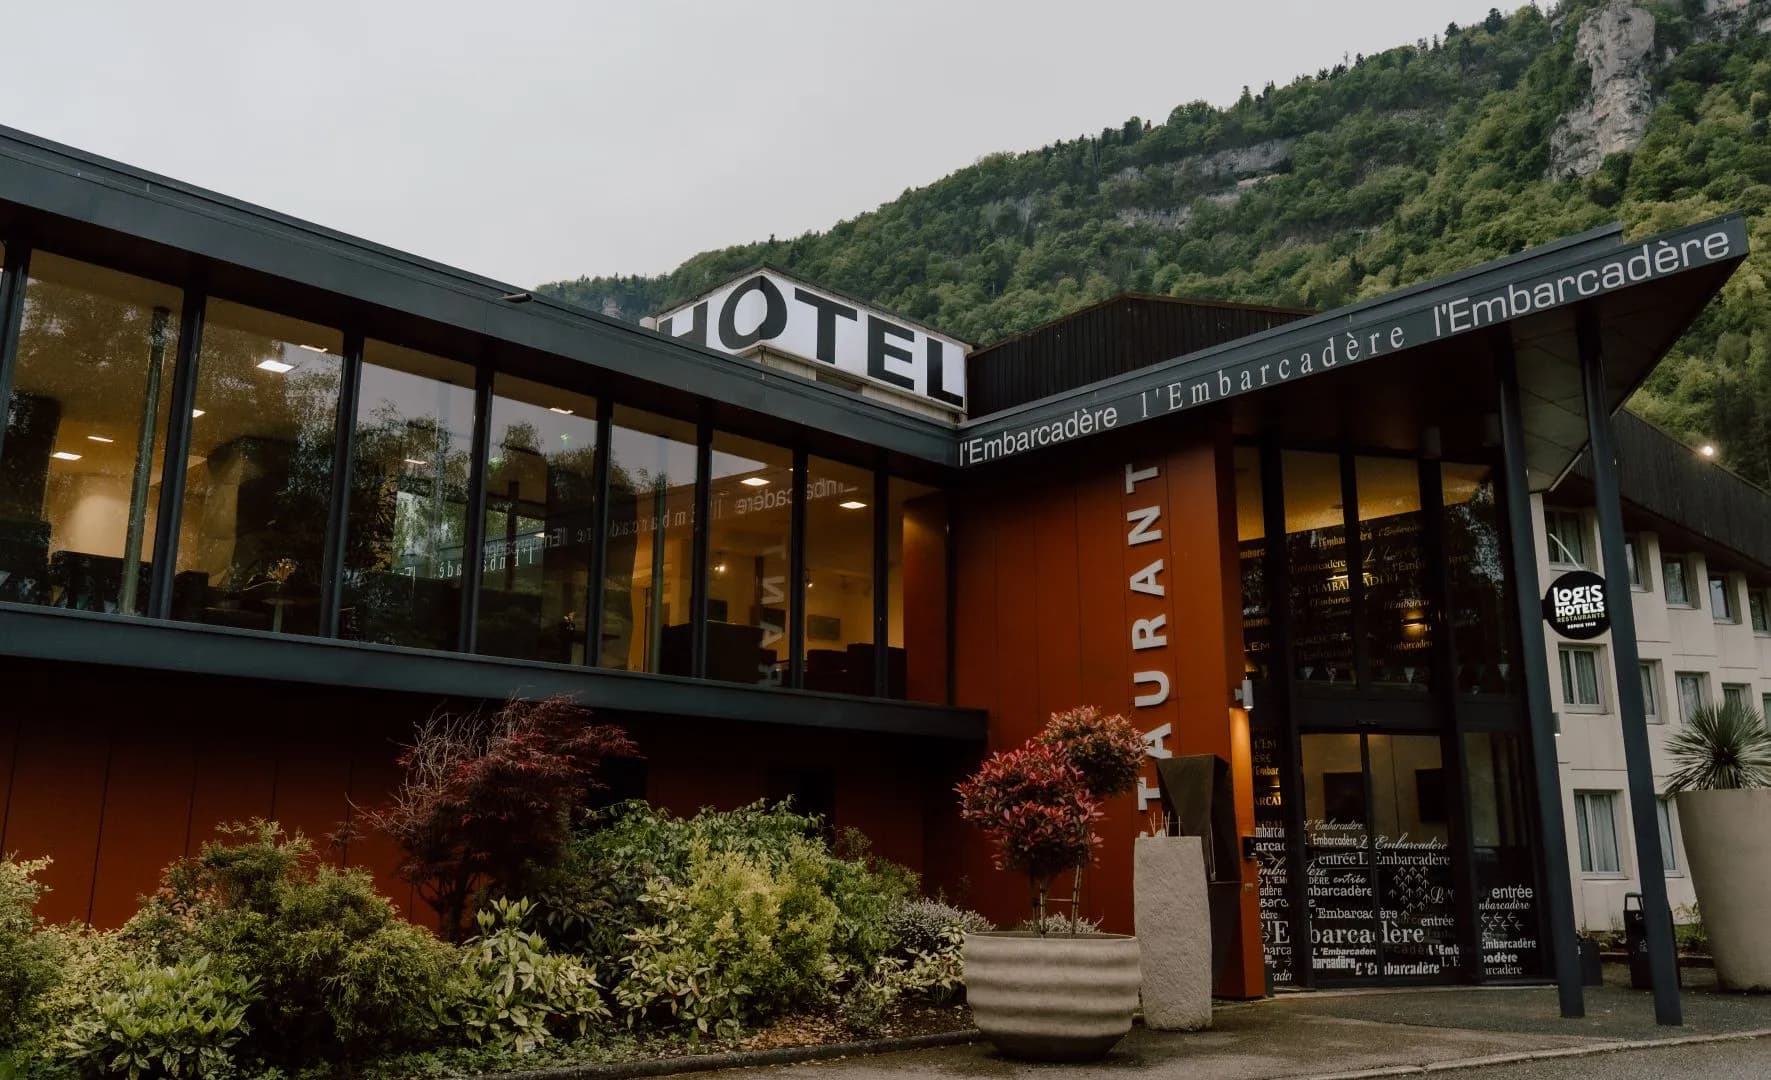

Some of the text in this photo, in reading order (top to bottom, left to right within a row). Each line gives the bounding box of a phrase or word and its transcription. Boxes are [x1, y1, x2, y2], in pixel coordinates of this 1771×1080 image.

[960, 231, 1729, 467] l'Embarcadère l'Embarcadère l'Embarcadère
[1555, 601, 1605, 617] HOTELS
[1491, 883, 1533, 899] entrée
